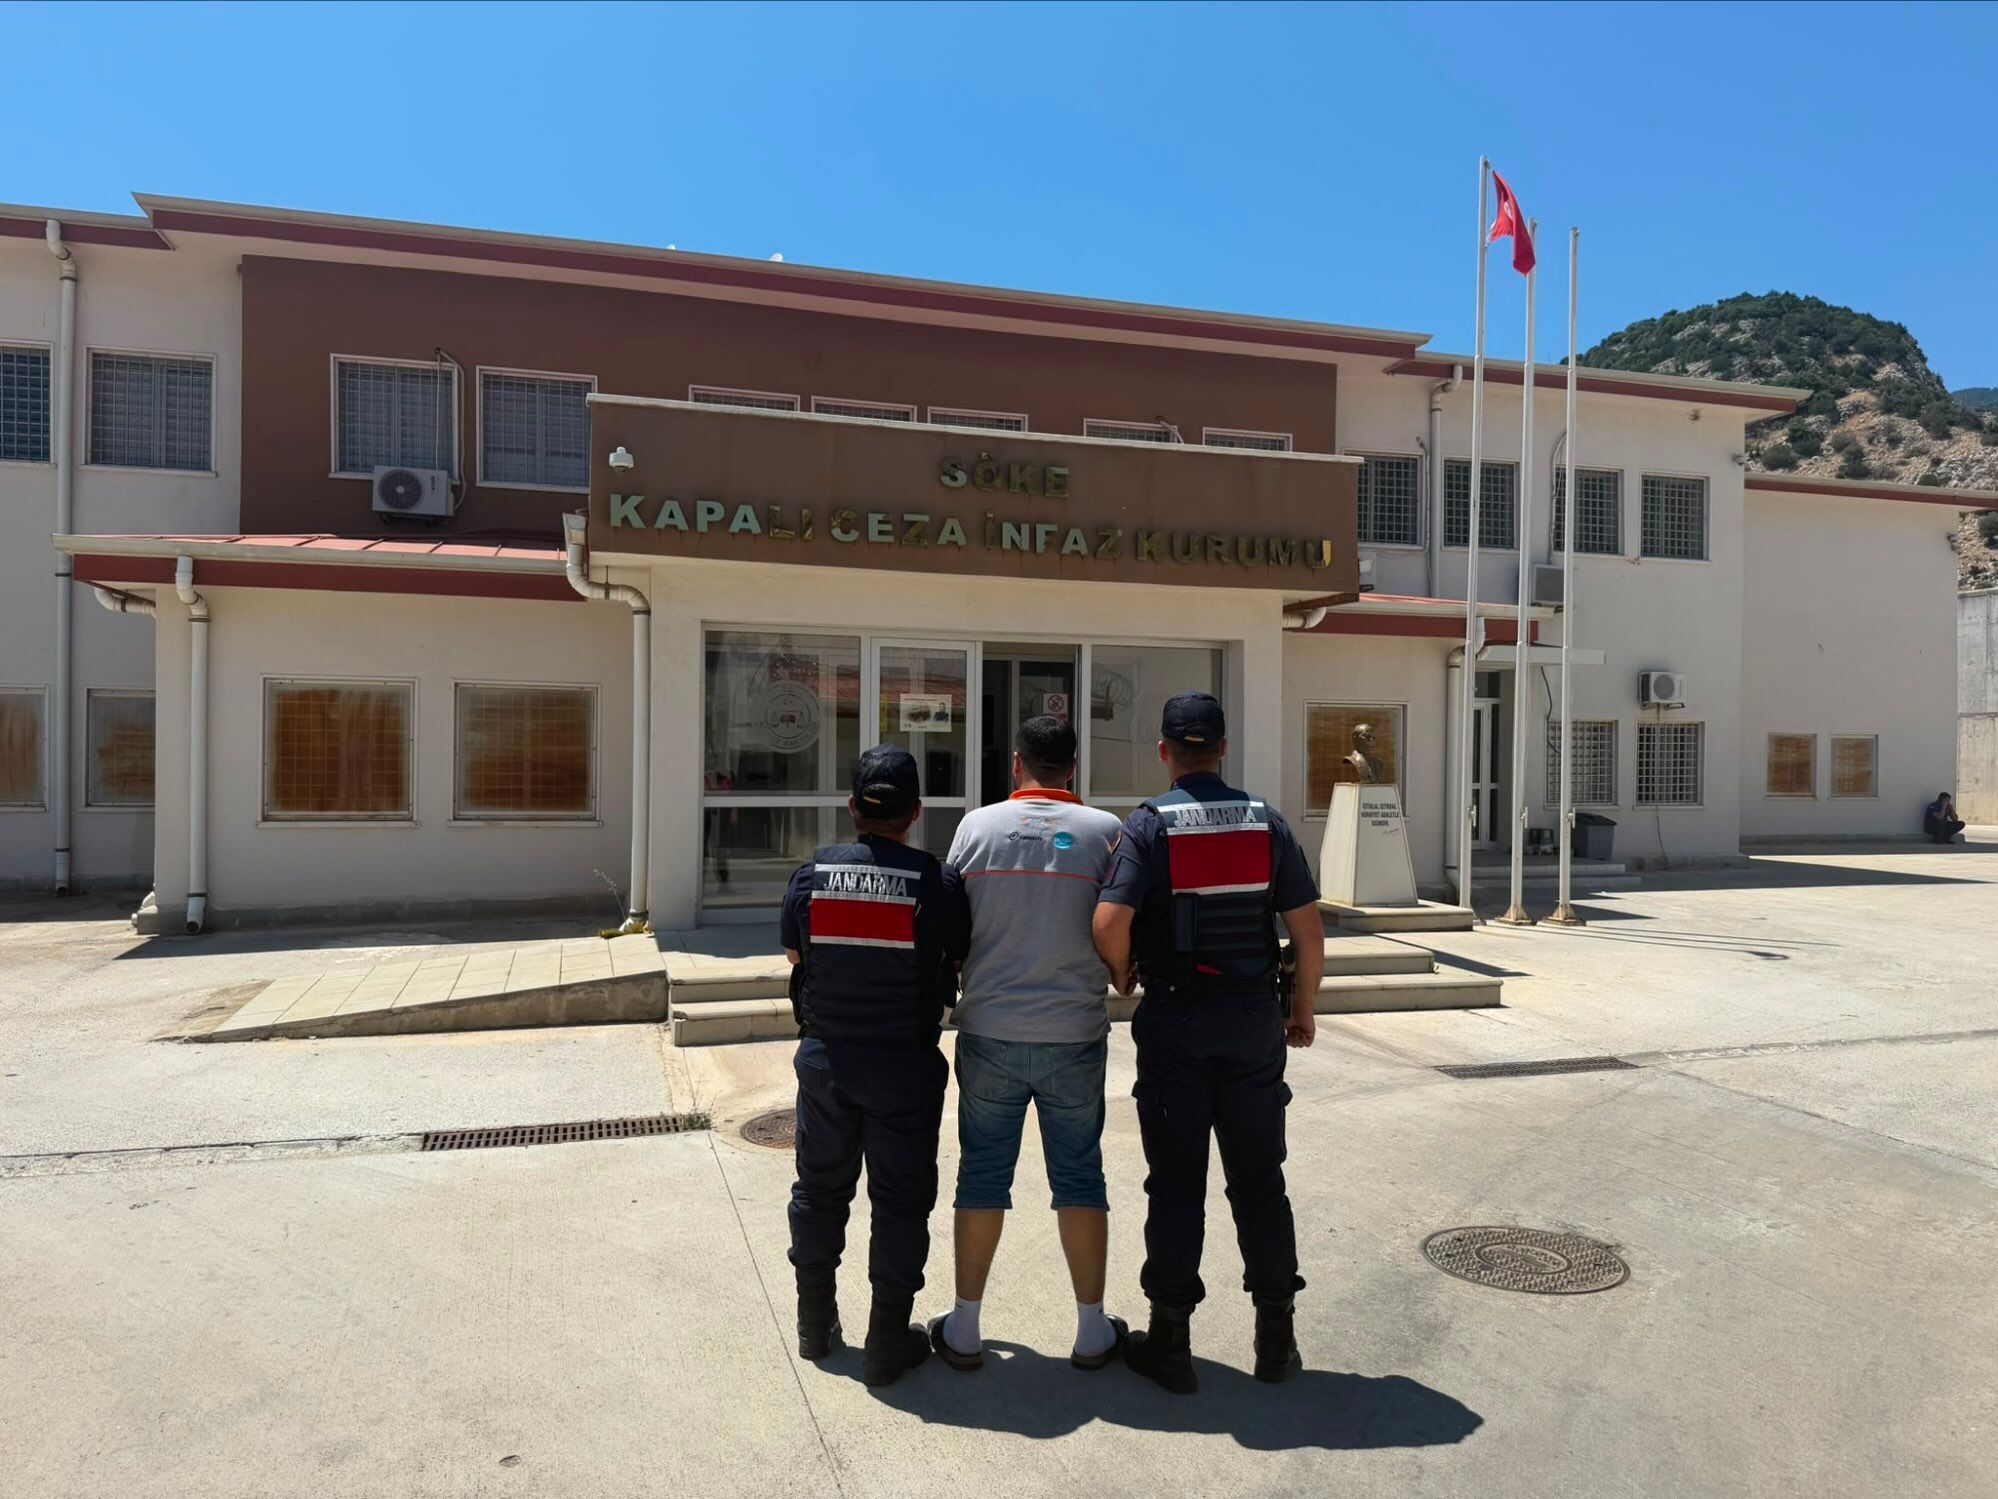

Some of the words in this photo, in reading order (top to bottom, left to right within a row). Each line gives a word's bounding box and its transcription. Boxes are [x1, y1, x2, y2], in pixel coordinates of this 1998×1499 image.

[940, 452, 1069, 497] SÖKE
[610, 494, 813, 541] KAPALI
[831, 509, 967, 546] CEZA
[984, 509, 1122, 559] İNFAZ
[1136, 530, 1332, 568] KURUMU
[1174, 807, 1257, 827] JANDARMA
[823, 871, 907, 897] JANDARMA
